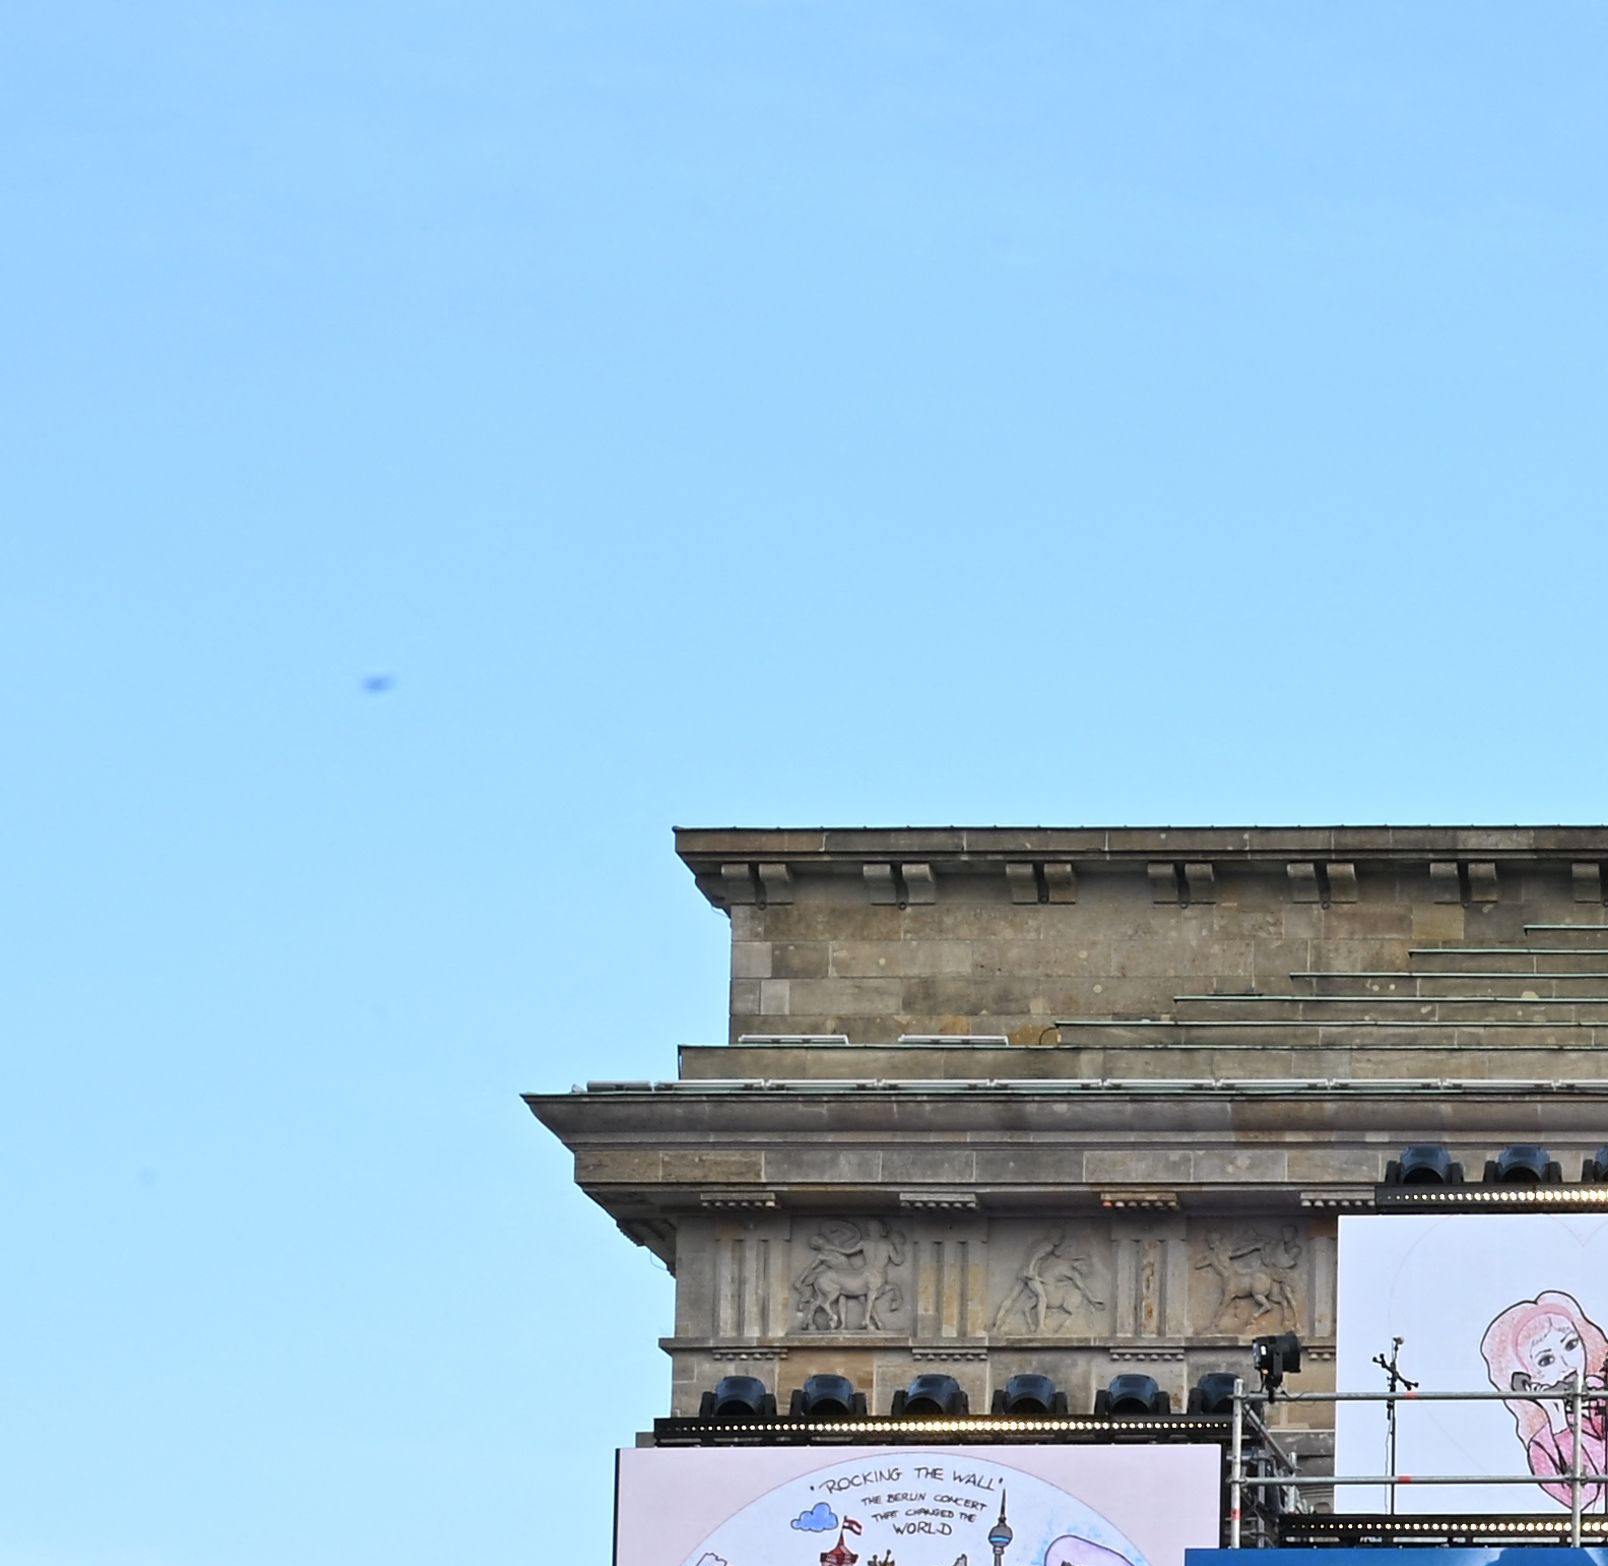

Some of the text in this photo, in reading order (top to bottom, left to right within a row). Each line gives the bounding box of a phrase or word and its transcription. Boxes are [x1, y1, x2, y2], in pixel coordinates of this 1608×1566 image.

[914, 1467, 944, 1480] THE
[861, 1493, 987, 1511] THE BERLIN CONCERT
[892, 1522, 952, 1536] WORLD
